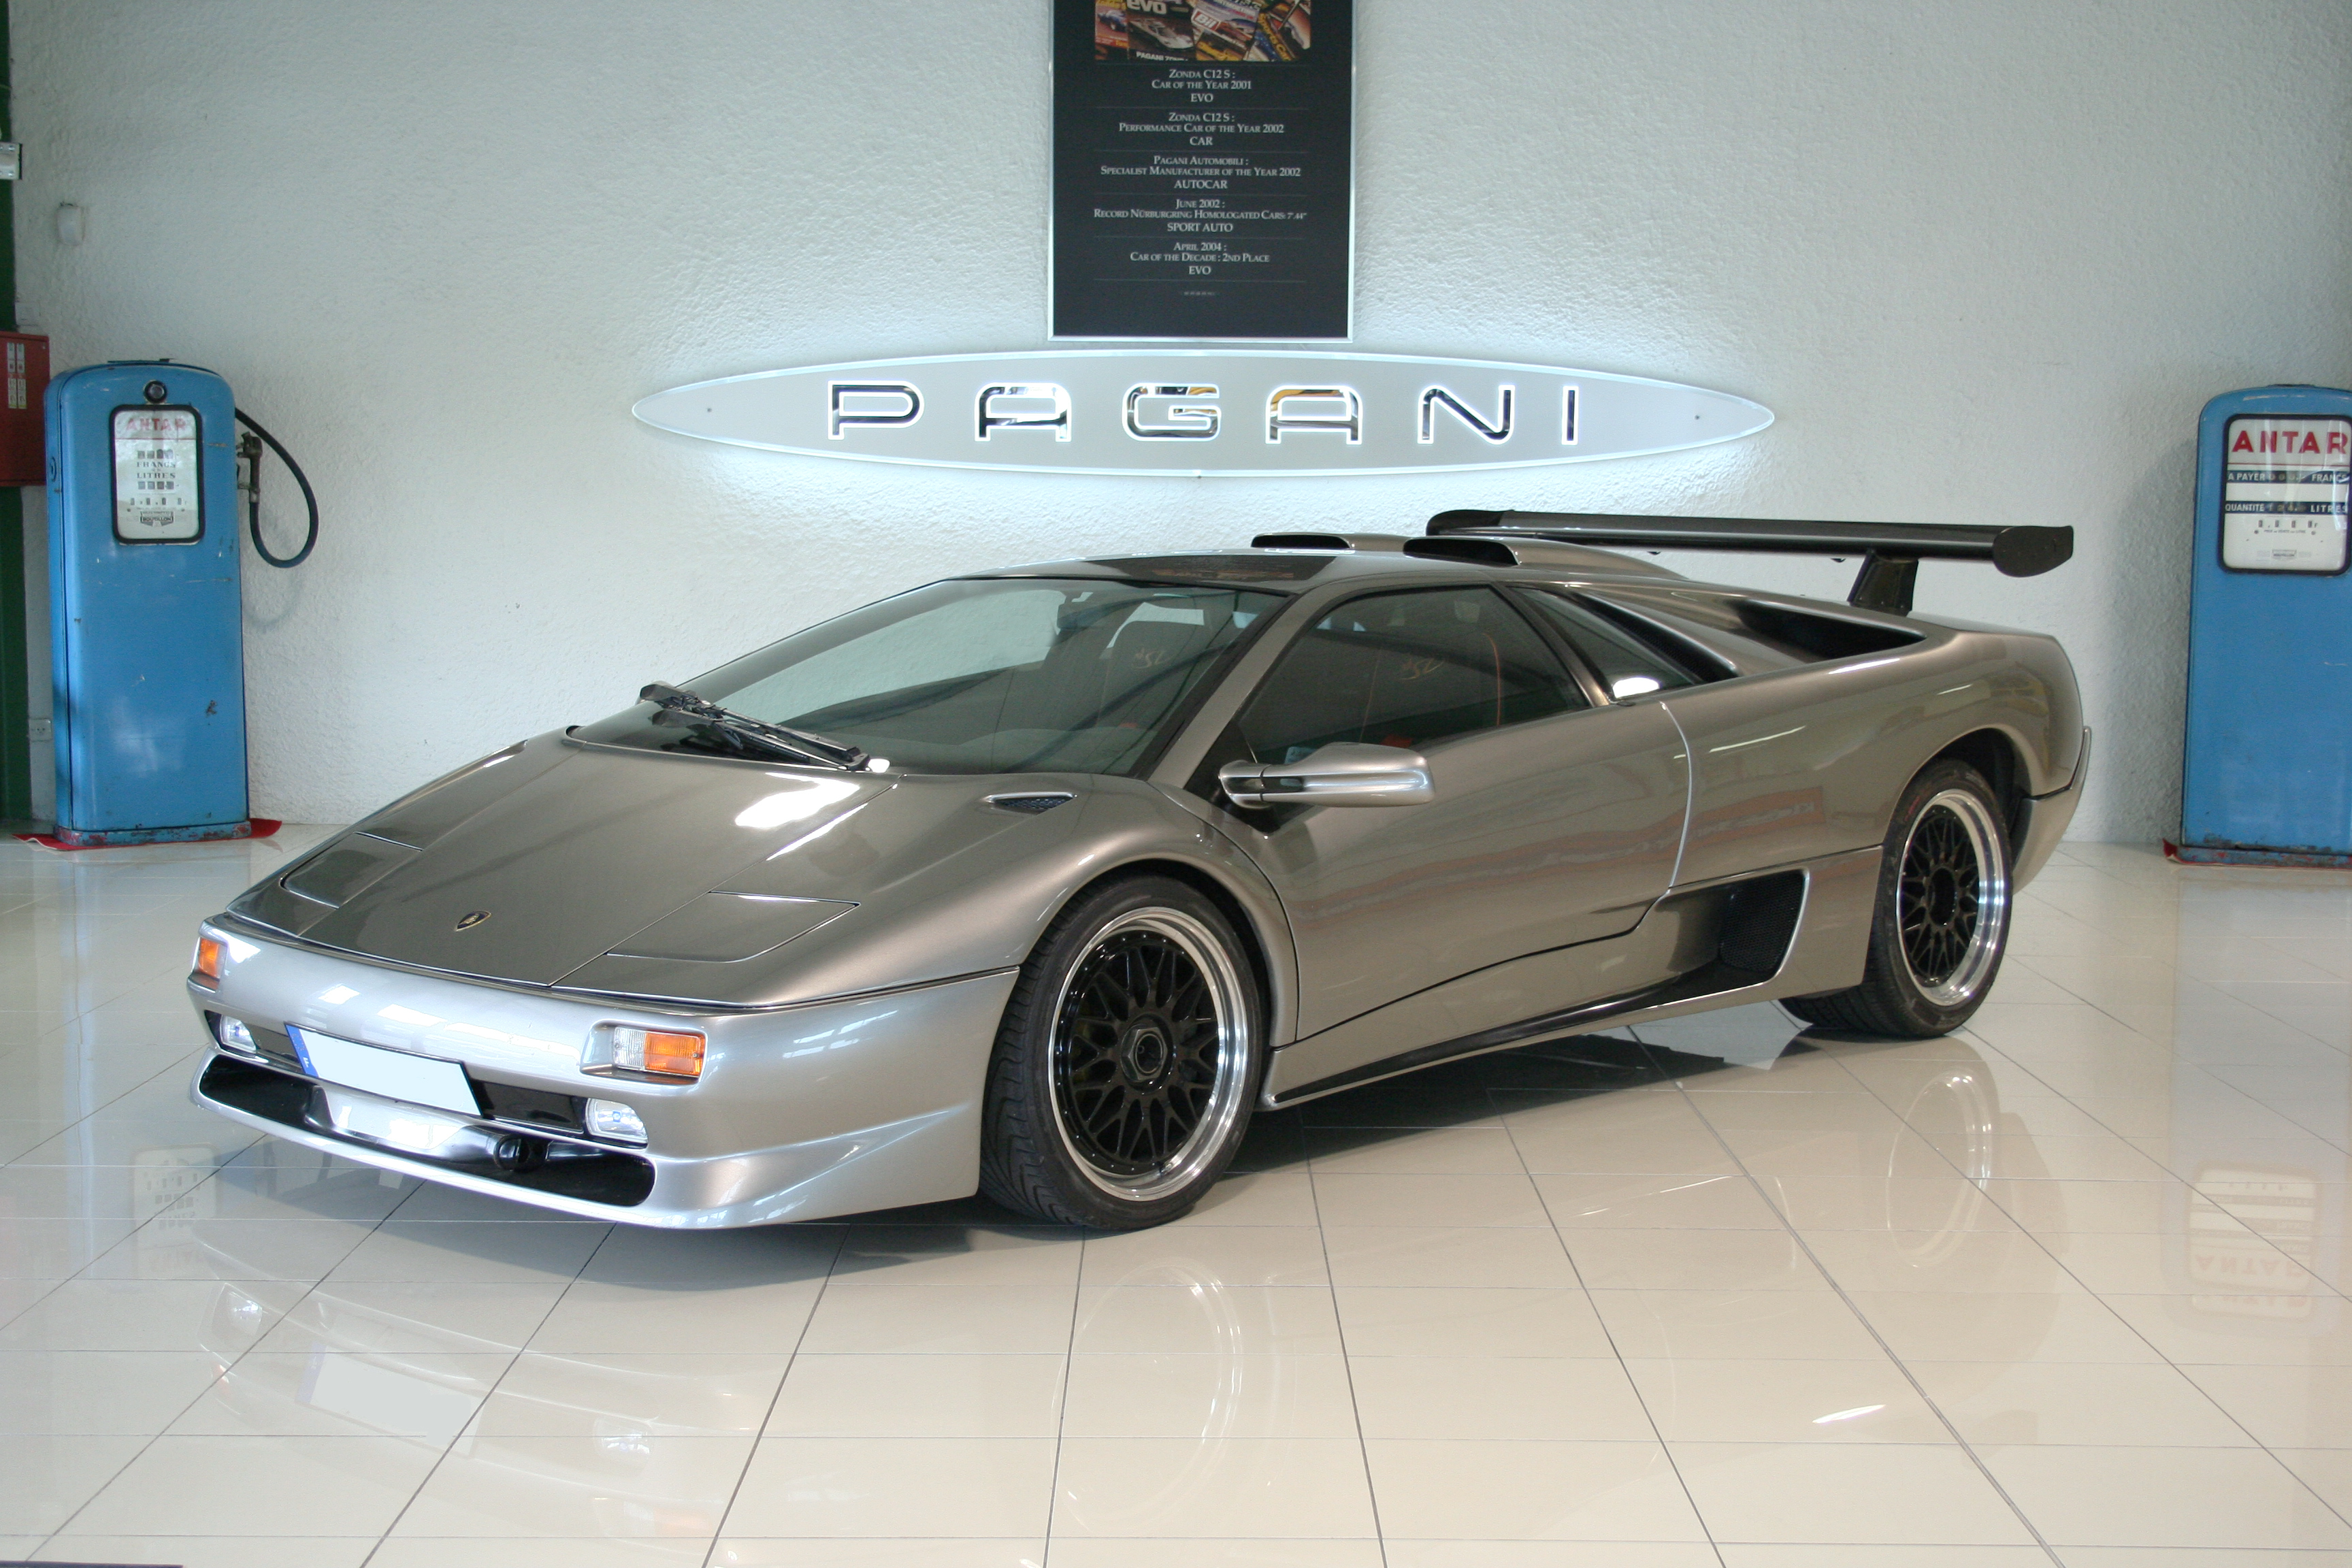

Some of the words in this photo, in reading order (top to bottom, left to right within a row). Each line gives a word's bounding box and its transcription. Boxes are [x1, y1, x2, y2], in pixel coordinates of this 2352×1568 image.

[1126, 0, 1166, 14] evo
[1169, 69, 1202, 78] ZONDA
[1203, 70, 1222, 79] C12
[1151, 80, 1171, 89] CAR
[1205, 80, 1229, 89] YEAR
[1230, 80, 1252, 90] 2001
[1190, 93, 1214, 103] EVO
[1168, 112, 1201, 122] ZONDA
[1203, 113, 1222, 122] C12
[1119, 122, 1182, 132] PERFORMANCE
[1183, 123, 1203, 133] CAR
[1237, 124, 1261, 133] YEAR
[1262, 124, 1284, 133] 2002
[1189, 137, 1213, 146] CAR
[1154, 156, 1188, 165] PAGANI
[1189, 157, 1243, 165] AUTOMOBILI
[1100, 166, 1147, 175] SPECIALIST
[1149, 166, 1220, 176] MANUFACTURER
[1254, 167, 1277, 176] YEAR
[1279, 167, 1301, 177] 2002
[1173, 180, 1228, 189] AUTOCAR
[1175, 199, 1198, 209] JUNE
[1198, 199, 1220, 208] 2002
[1094, 209, 1129, 218] RECORD
[1194, 210, 1260, 219] HOMOLOGATED
[1167, 223, 1201, 232] SPORT
[1202, 223, 1234, 233] AUTO
[1173, 242, 1199, 251] APRIL
[1200, 242, 1222, 251] 2004
[1130, 252, 1149, 261] CAR
[1181, 252, 1217, 262] DECADE
[1242, 253, 1269, 263] PLACE
[1188, 266, 1211, 275] EVO
[828, 380, 1579, 445] PAGANI
[2232, 430, 2348, 454] ANTAR
[2237, 473, 2266, 481] PAYER
